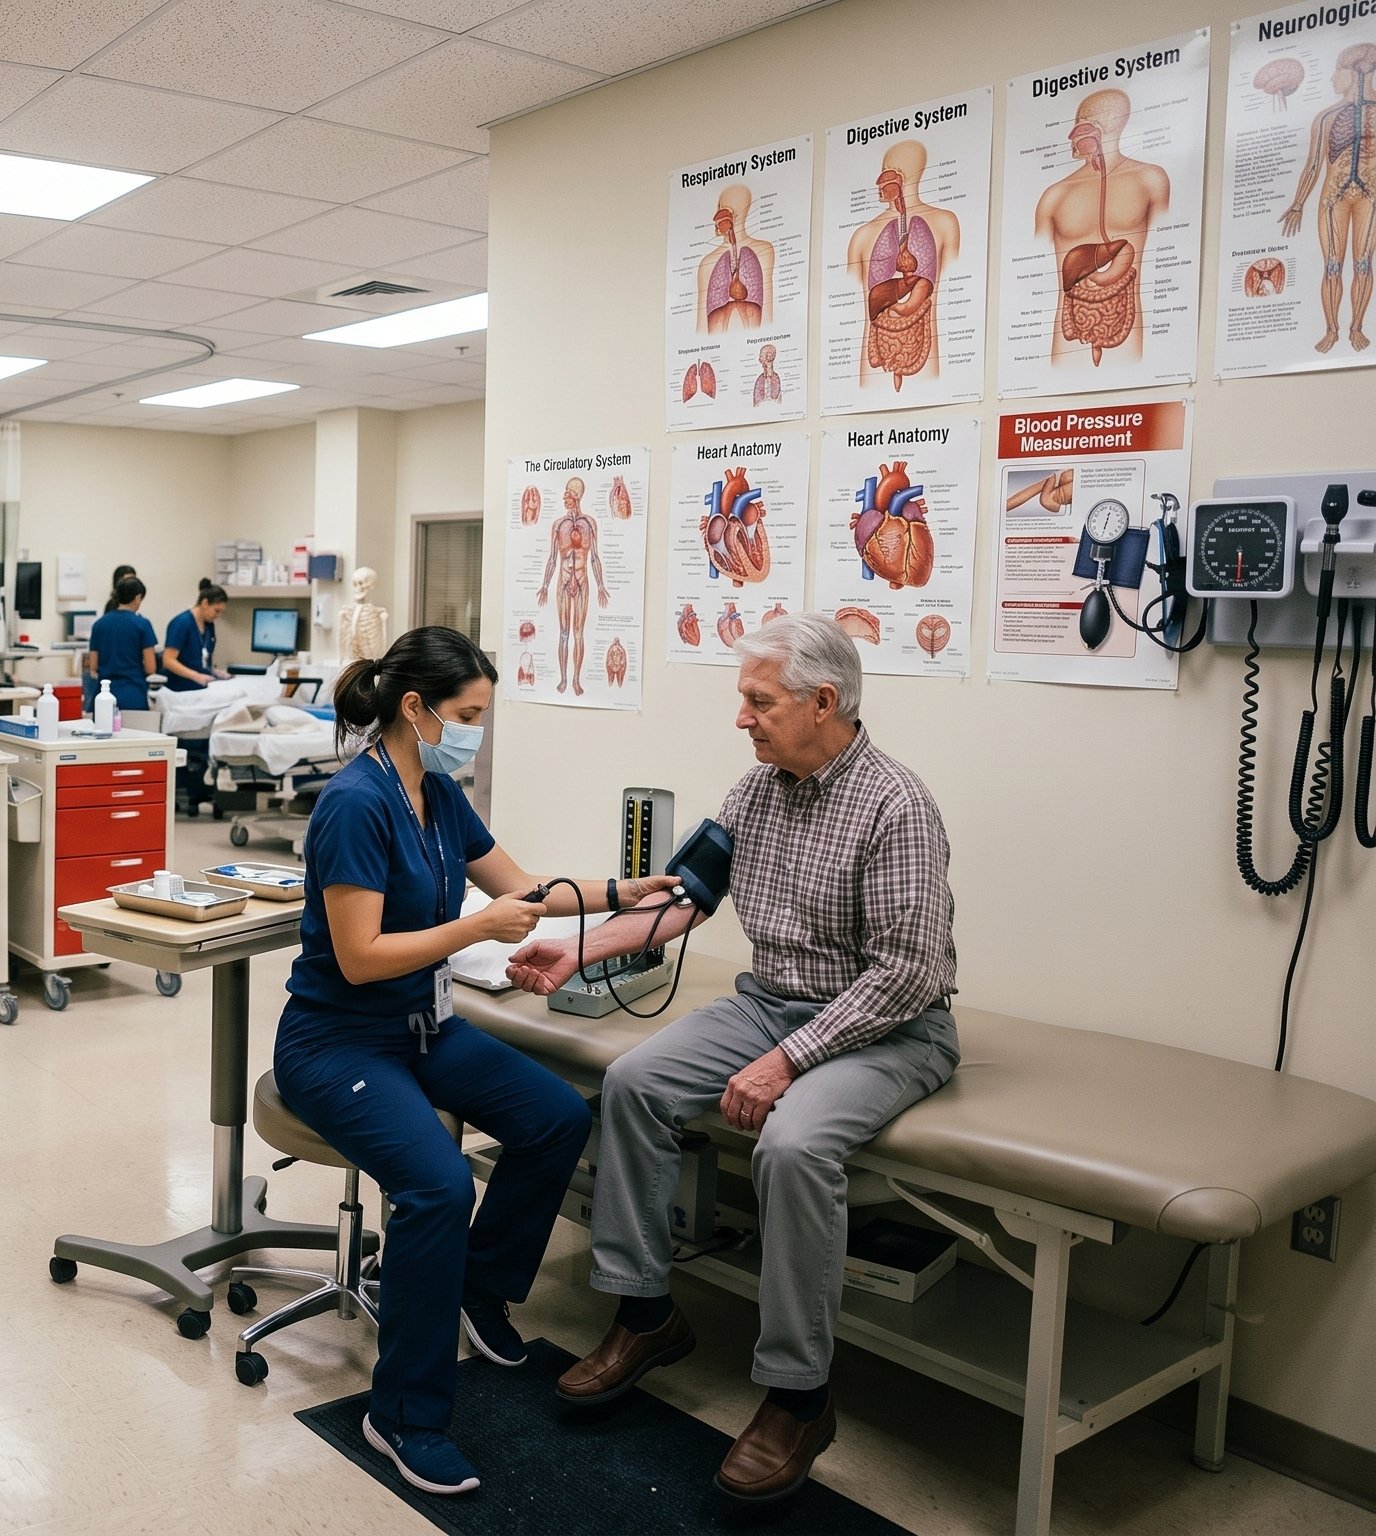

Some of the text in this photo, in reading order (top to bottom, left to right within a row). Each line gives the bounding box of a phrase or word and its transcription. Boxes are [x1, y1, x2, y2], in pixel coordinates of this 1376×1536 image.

[1032, 48, 1180, 98] Digestive System
[847, 103, 968, 146] Digestive System
[681, 147, 796, 189] Respiratory System
[1014, 413, 1143, 434] Blood Pressure
[848, 427, 950, 448] Heart Anatomy
[1021, 433, 1132, 452] Measurement
[697, 442, 782, 460] Heart Anatomy
[524, 453, 631, 472] The Circulatory System
